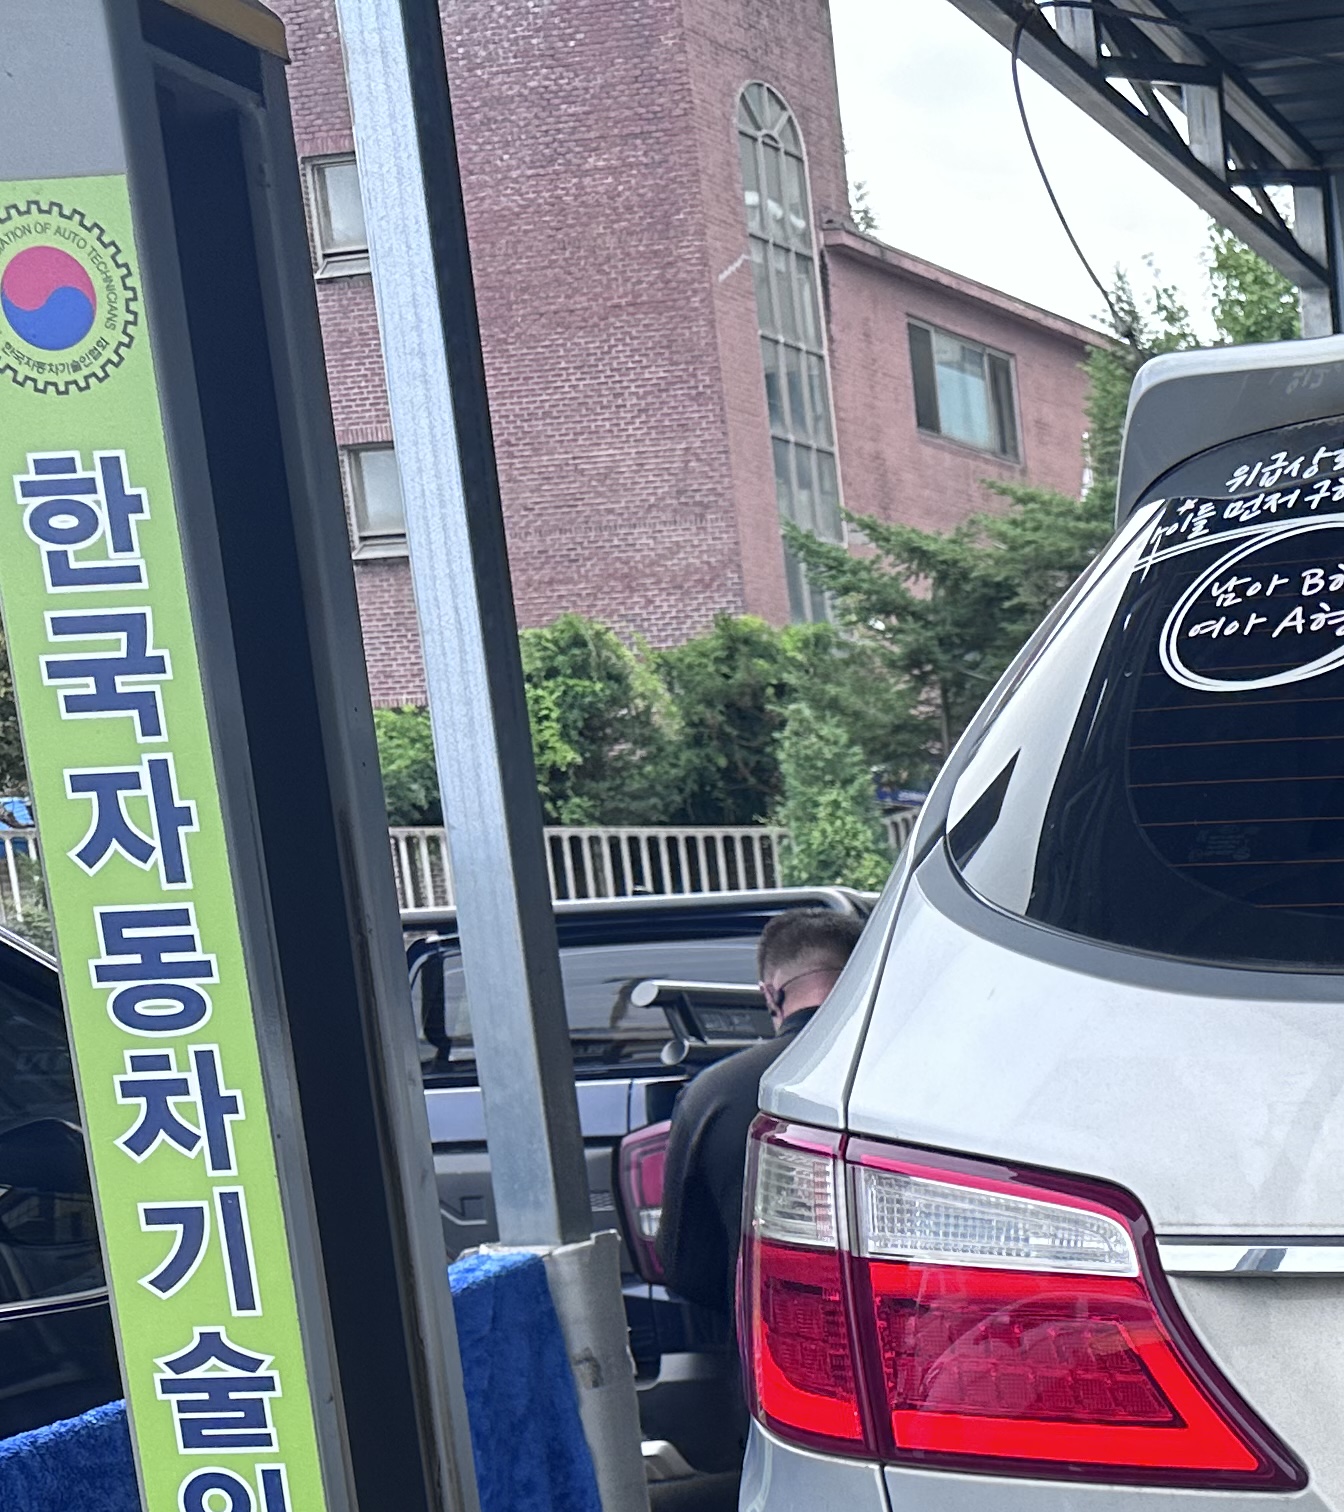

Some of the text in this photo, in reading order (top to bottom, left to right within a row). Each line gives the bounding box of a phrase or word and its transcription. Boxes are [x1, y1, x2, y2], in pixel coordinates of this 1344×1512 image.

[1222, 485, 1301, 521] 먼저
[1210, 574, 1289, 608] 남아
[1188, 611, 1267, 640] 여아
